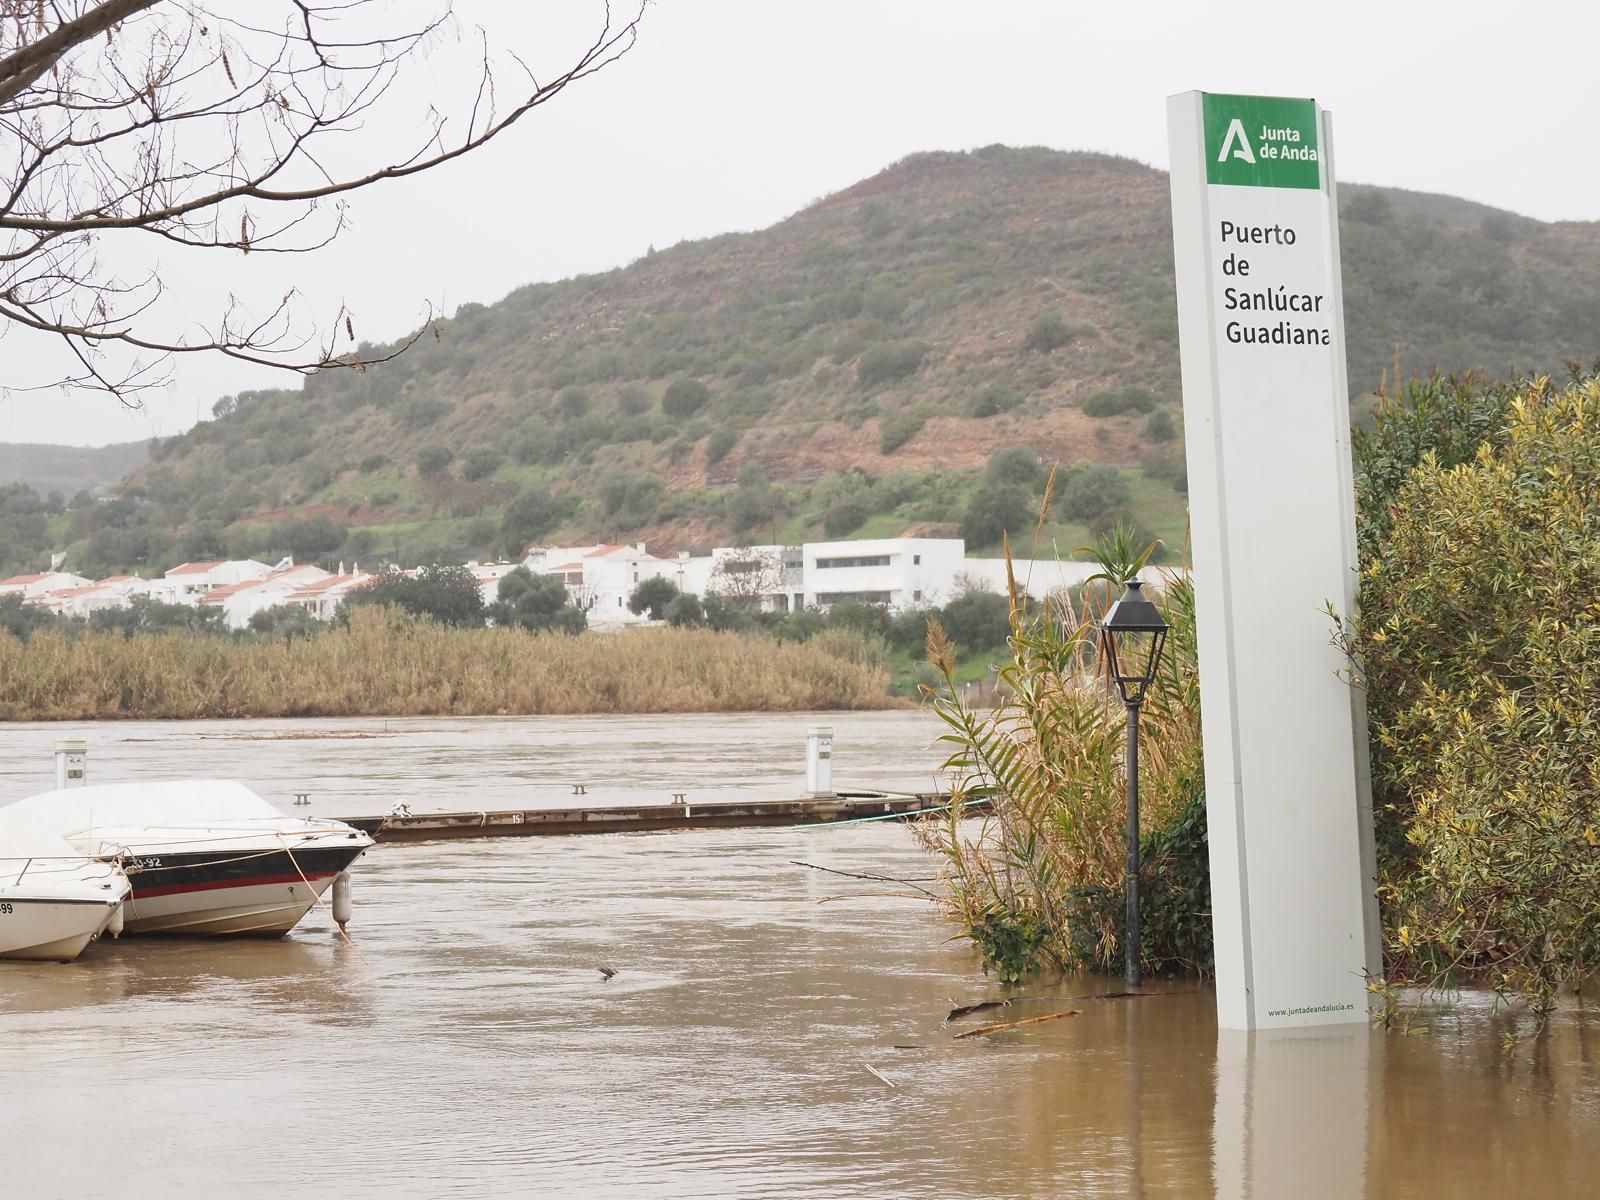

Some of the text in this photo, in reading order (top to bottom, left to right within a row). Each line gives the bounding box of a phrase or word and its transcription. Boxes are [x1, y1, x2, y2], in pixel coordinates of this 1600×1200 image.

[1259, 125, 1301, 142] Junta
[1260, 142, 1278, 159] de
[1220, 220, 1296, 246] Puerto
[1222, 252, 1250, 276] de
[1224, 285, 1324, 313] Sanlúcar
[1226, 321, 1330, 346] Guadiana
[1268, 1003, 1354, 1016] www.juntadeandalucia.es
